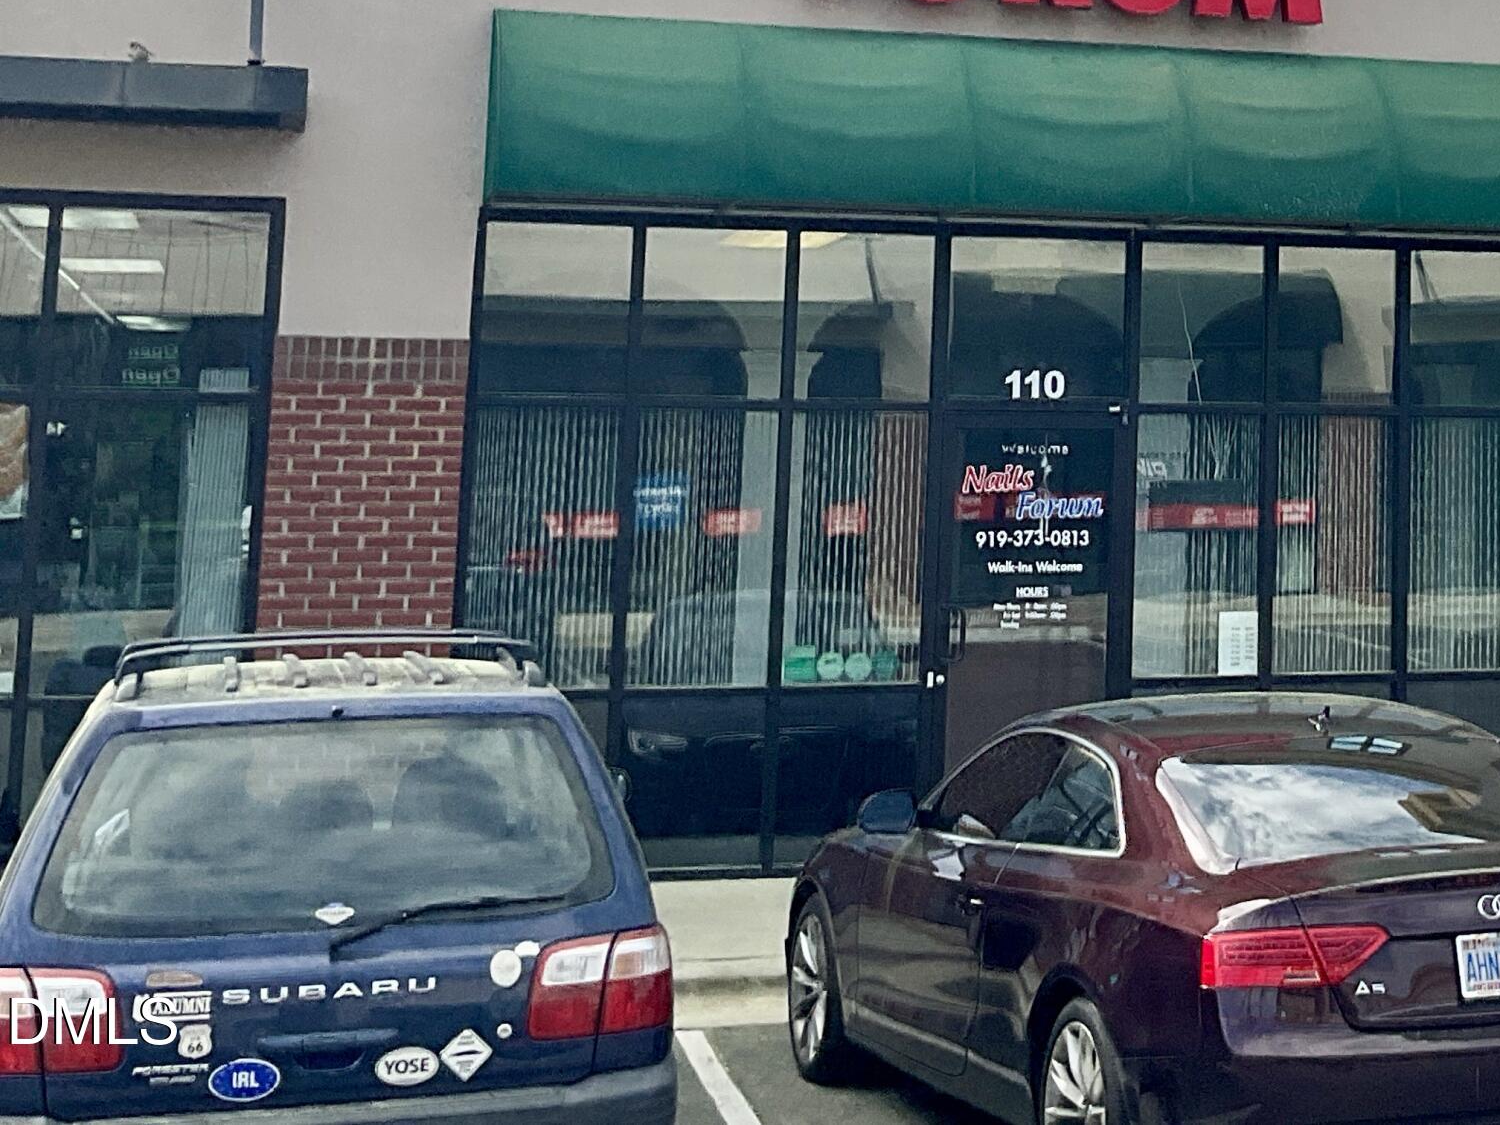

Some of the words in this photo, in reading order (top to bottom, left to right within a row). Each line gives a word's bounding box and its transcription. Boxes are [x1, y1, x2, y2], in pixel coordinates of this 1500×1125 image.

[1005, 369, 1066, 400] 110
[962, 464, 1035, 494] Nails
[1016, 491, 1104, 520] Forum
[975, 529, 1090, 549] 919-373-0813
[987, 560, 1033, 574] Walk-Ins
[1035, 559, 1083, 573] Welcome
[1015, 586, 1049, 598] HOURS
[222, 976, 436, 1005] SUBARU
[1355, 980, 1386, 995] A5
[188, 1042, 204, 1054] 66
[385, 1057, 430, 1075] YOSE
[232, 1071, 260, 1088] IRL
